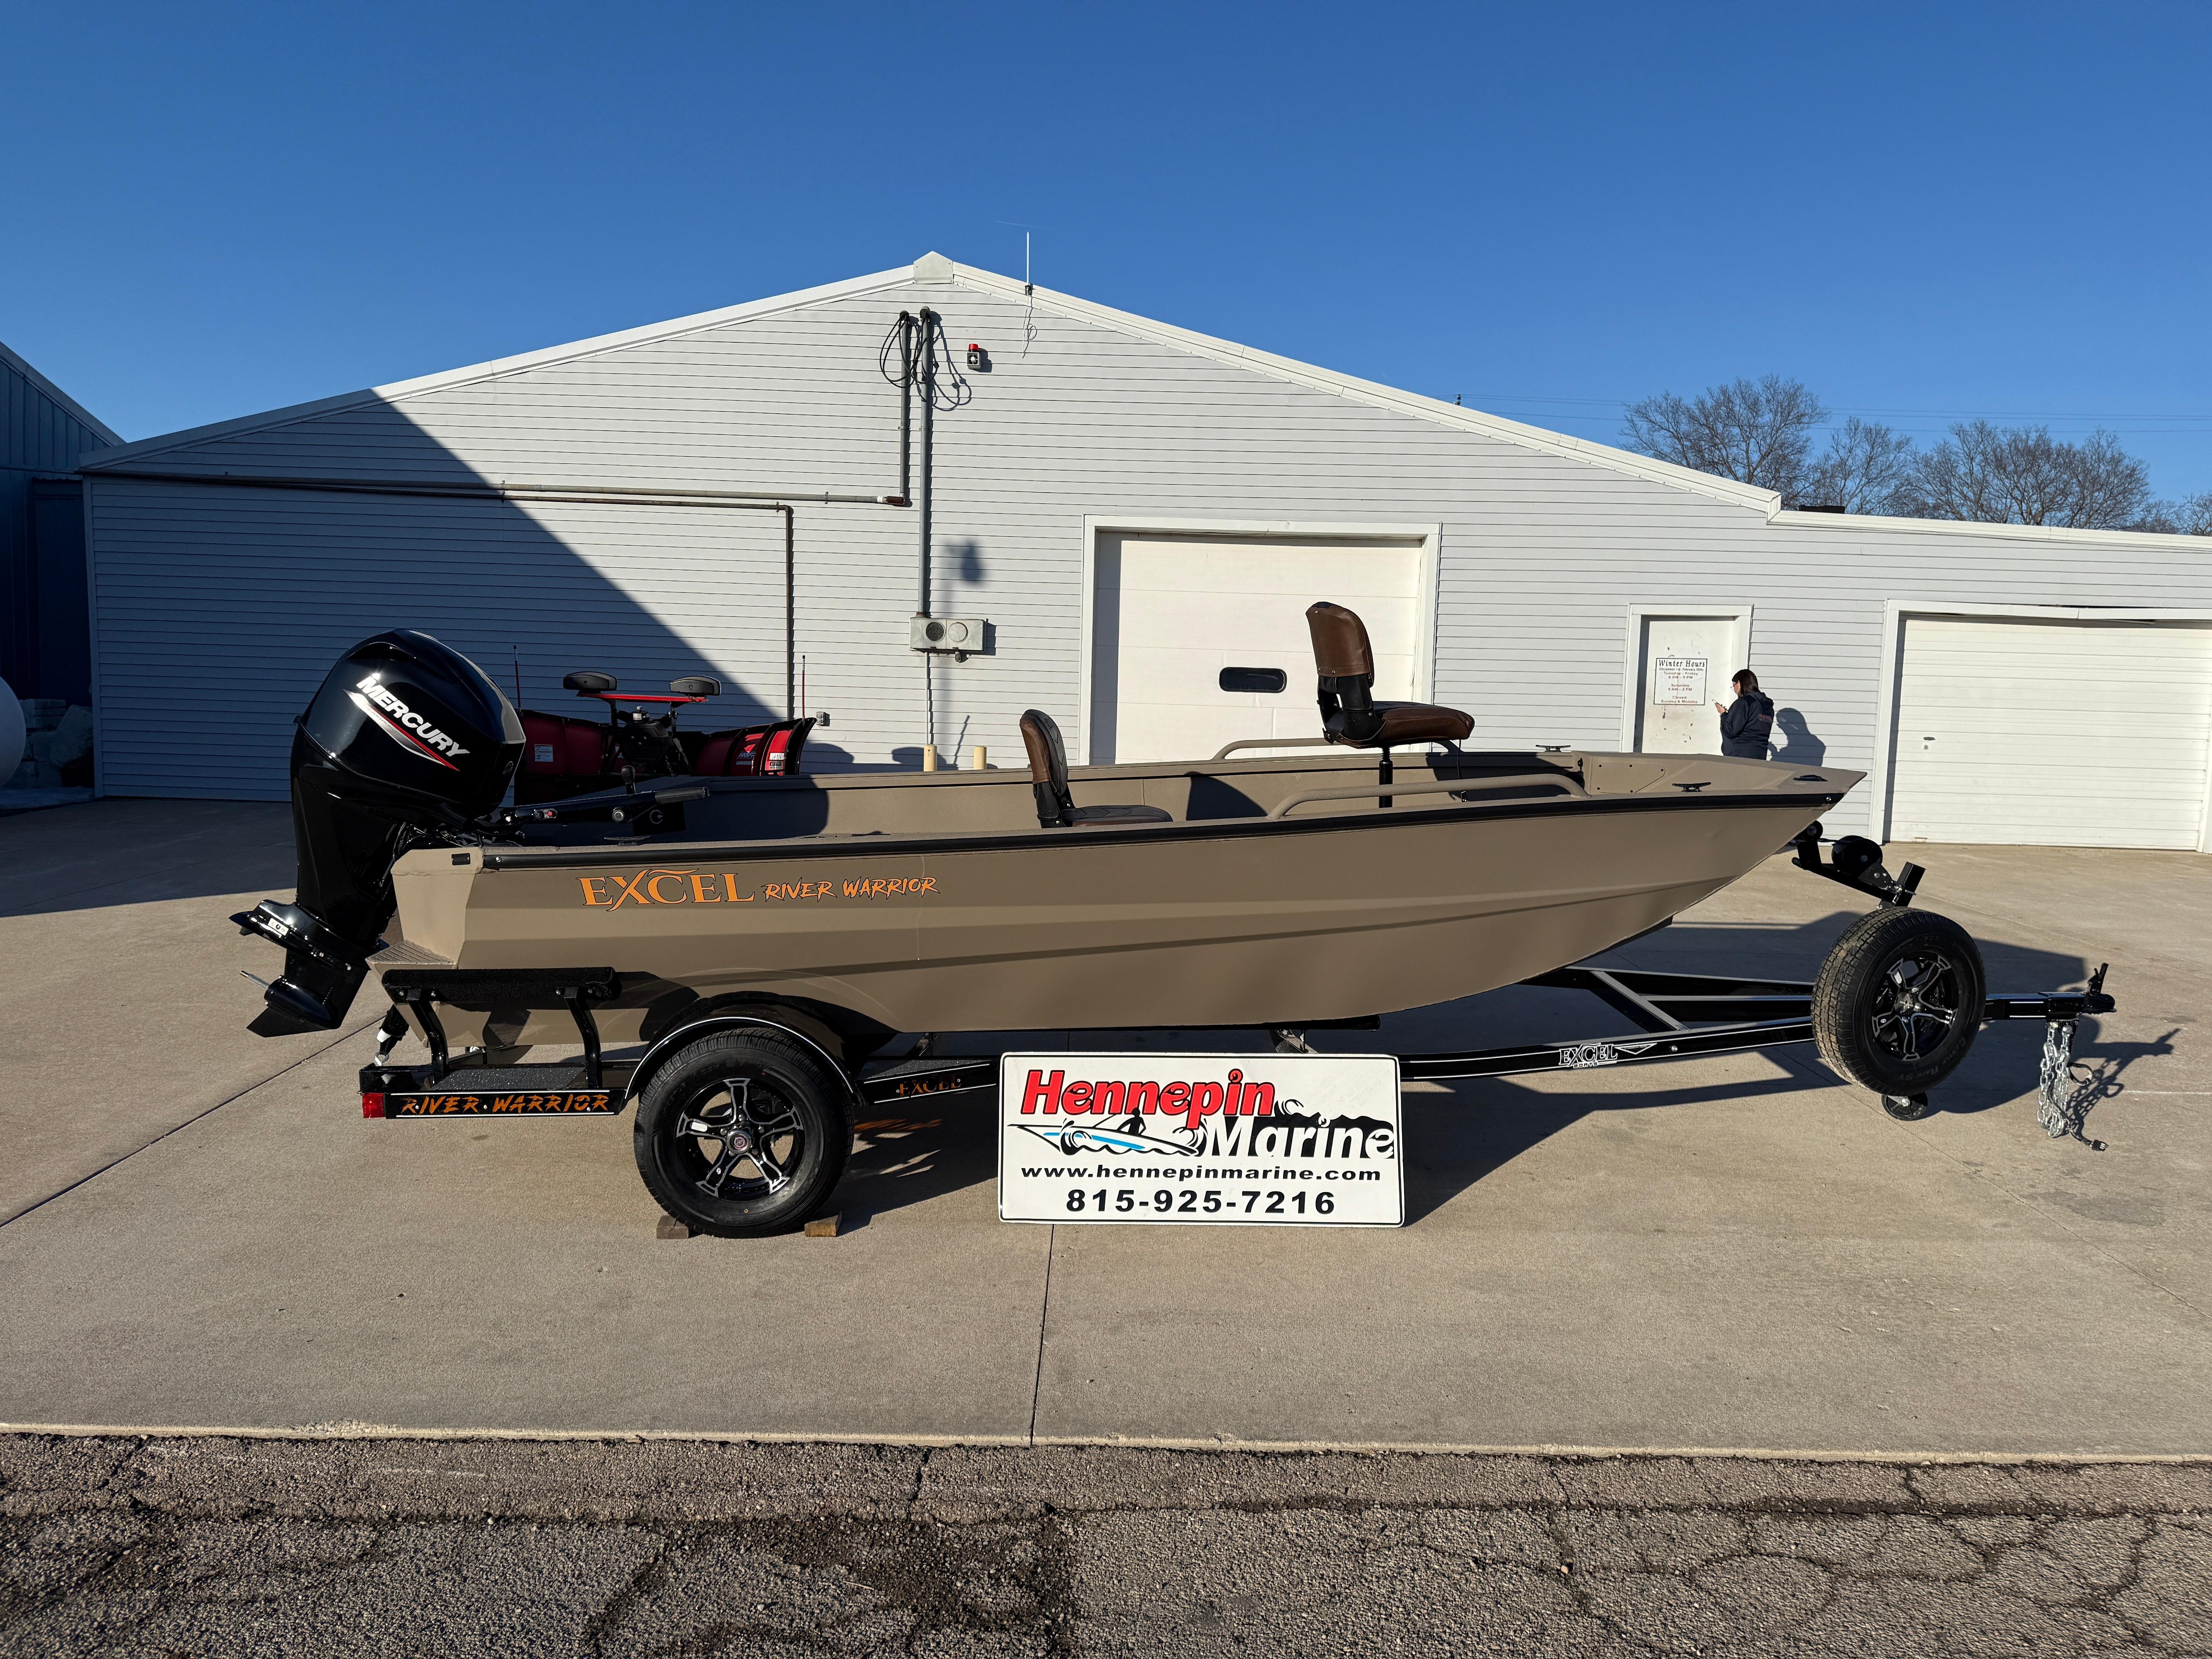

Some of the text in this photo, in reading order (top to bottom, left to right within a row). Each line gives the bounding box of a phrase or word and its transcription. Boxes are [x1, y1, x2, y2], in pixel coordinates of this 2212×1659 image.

[356, 676, 470, 757] MERCURY
[575, 869, 941, 912] EXCEL RIVER WARRIOR
[1559, 1042, 1618, 1067] EXCEL
[400, 1093, 609, 1115] RIVER WARRIOR
[1020, 1068, 1276, 1130] Hennepin
[1211, 1112, 1394, 1159] Marine
[1021, 1164, 1381, 1181] www.hennepinmarine.com
[1066, 1189, 1334, 1214] 815-925-7216
